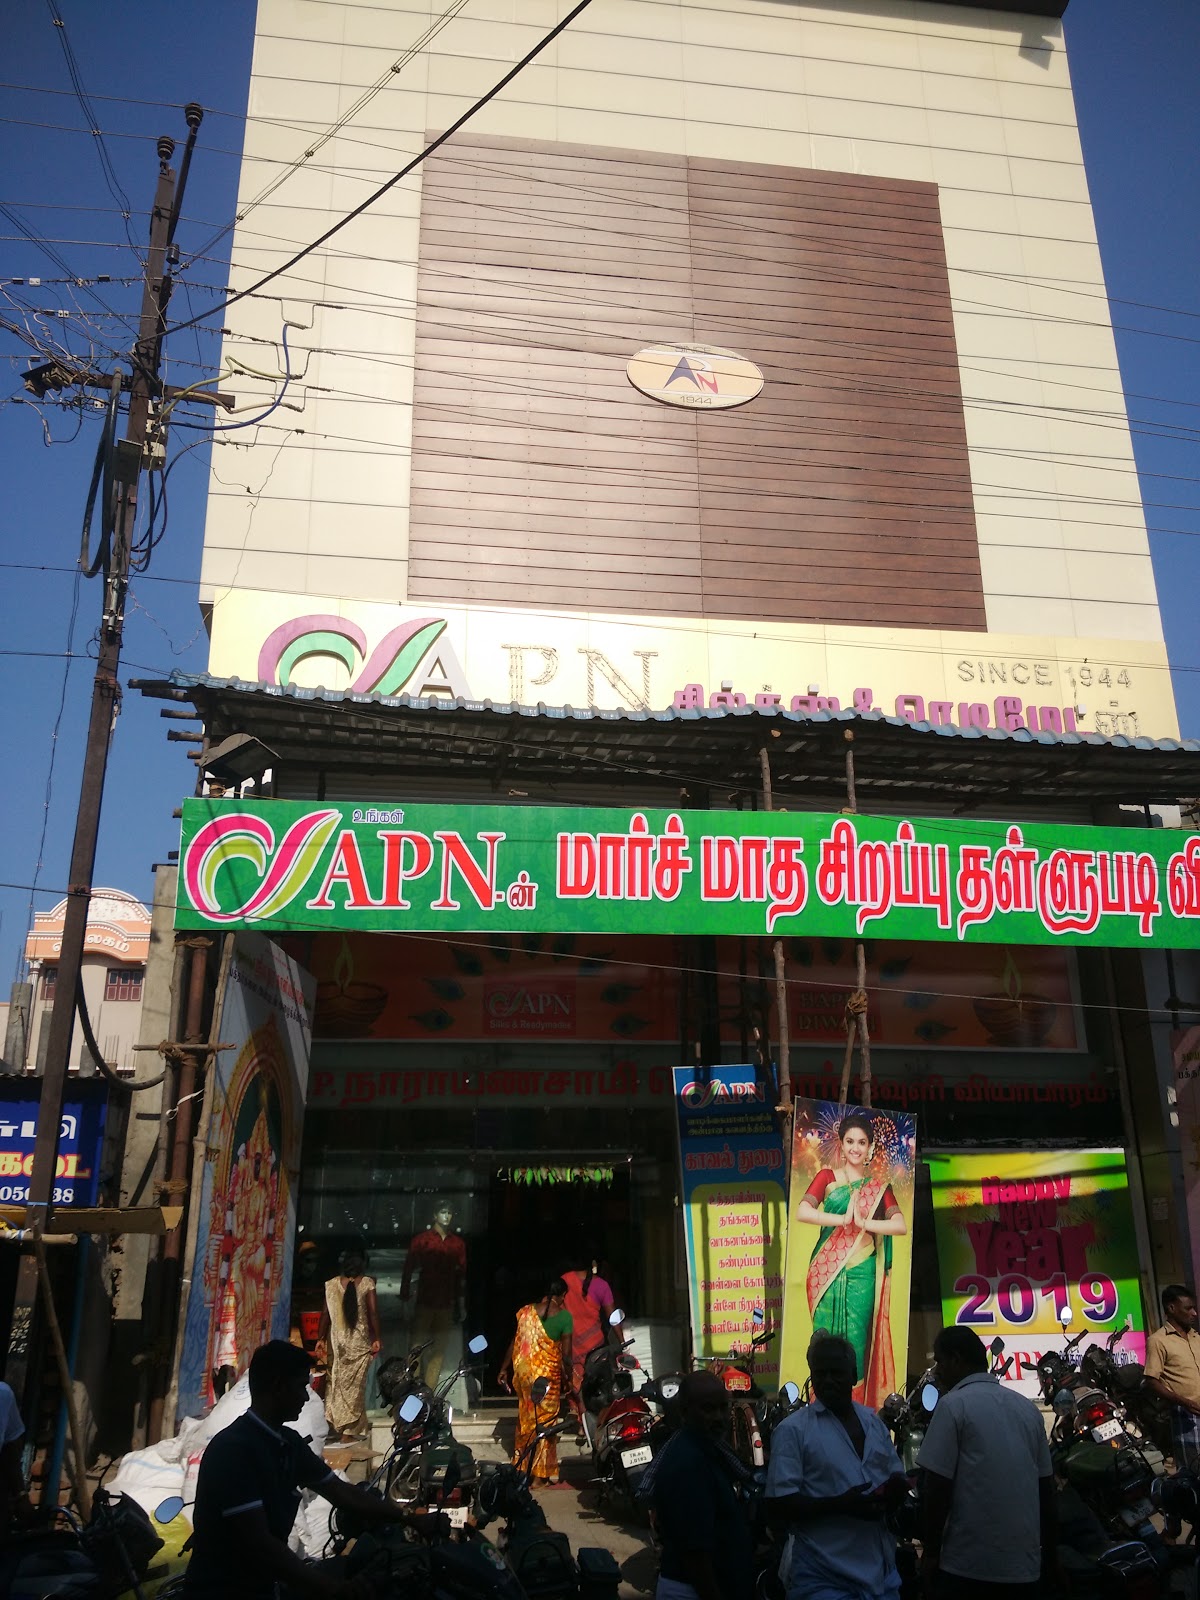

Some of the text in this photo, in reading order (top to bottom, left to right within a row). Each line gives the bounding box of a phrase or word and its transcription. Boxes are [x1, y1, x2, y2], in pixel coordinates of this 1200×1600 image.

[680, 395, 712, 405] 1944
[957, 660, 1132, 688] SINCE 1944
[353, 808, 404, 825] உங்கள்
[555, 811, 693, 902] மார்ச்
[700, 835, 809, 934] மாத
[816, 818, 952, 935] சிறப்பு
[957, 824, 1162, 941] தள்ளுபடி
[520, 993, 573, 1015] APN
[340, 1060, 637, 1108] நாராயணசாமி
[713, 1081, 767, 1105] APN
[685, 1142, 783, 1175] காவல் துறை
[719, 1212, 760, 1228] தங்களது
[709, 1233, 772, 1248] வாகனங்களை
[966, 1220, 1096, 1281] Year
[718, 1254, 768, 1269] கண்டிப்பாக
[700, 1277, 742, 1291] வெள்ளை
[705, 1298, 737, 1312] உள்ளே
[953, 1271, 1119, 1325] 2019
